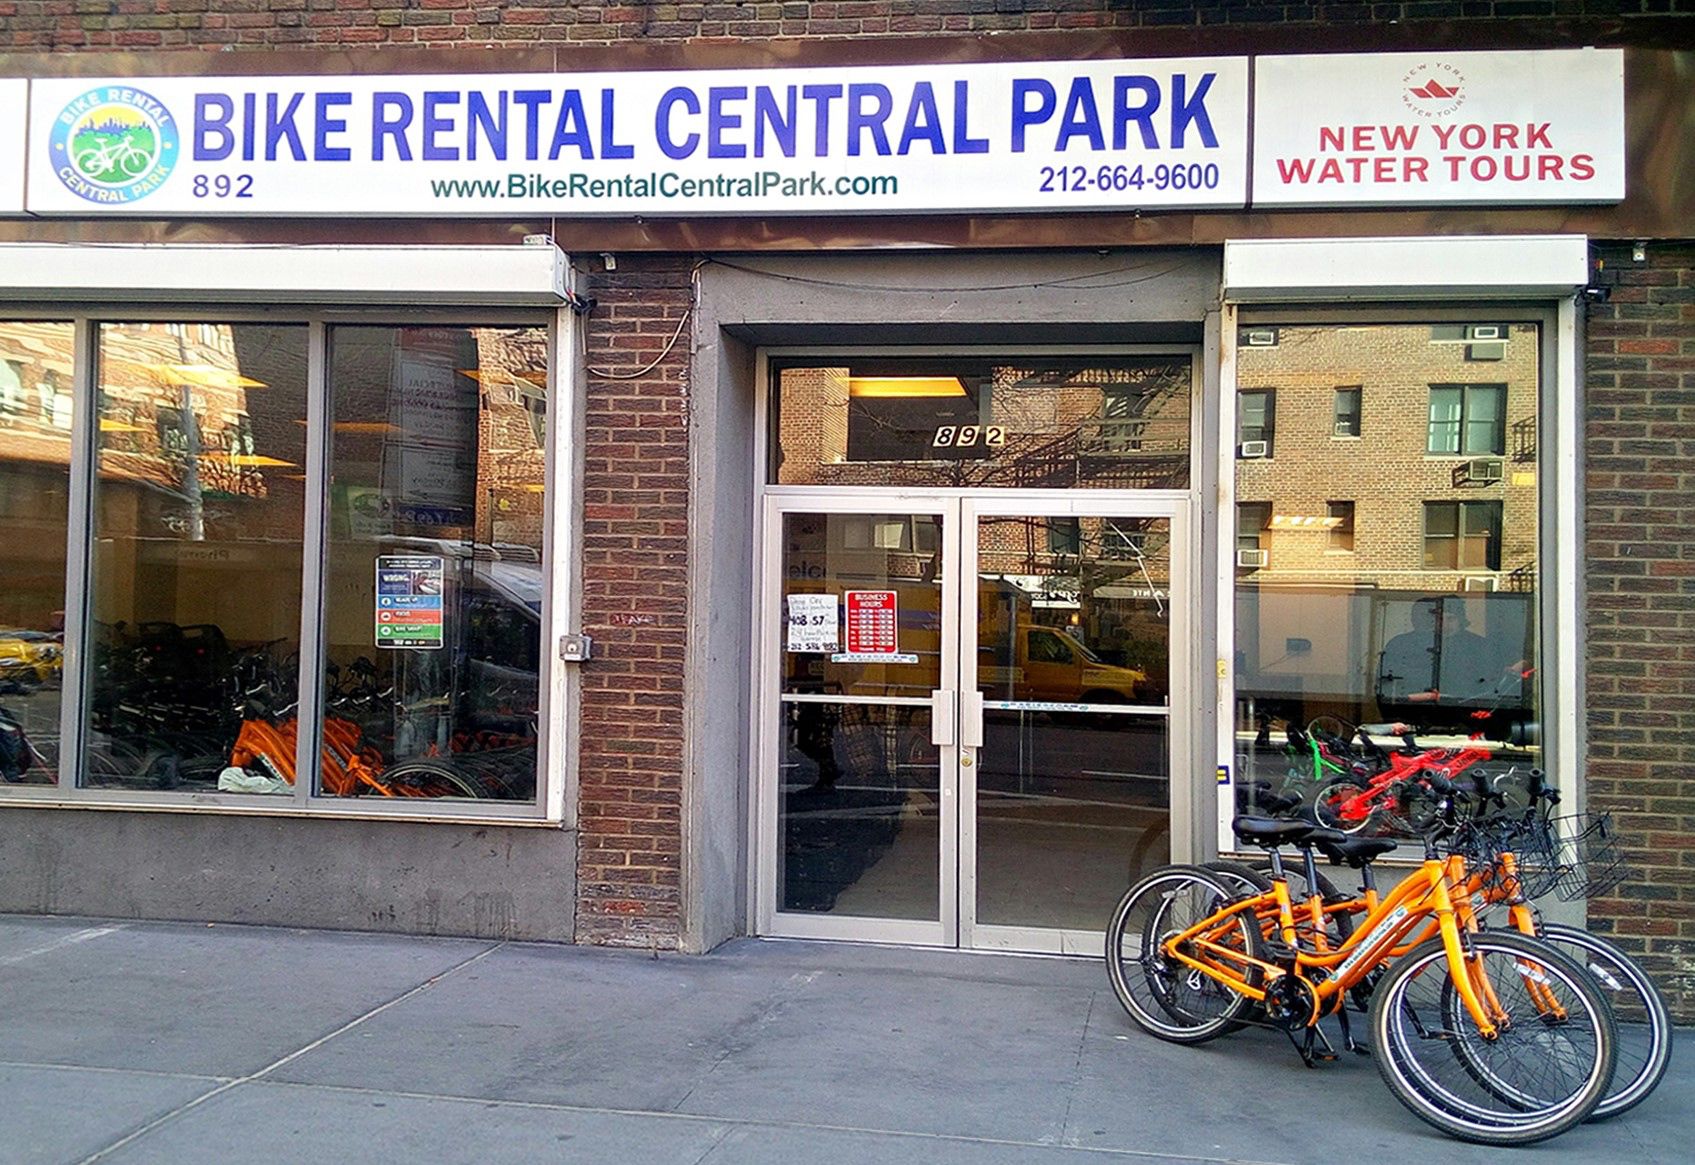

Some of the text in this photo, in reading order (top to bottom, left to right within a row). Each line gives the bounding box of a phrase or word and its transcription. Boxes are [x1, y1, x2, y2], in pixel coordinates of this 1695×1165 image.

[1402, 61, 1466, 83] NEW YORK
[59, 88, 171, 128] BIKE RENTAL
[192, 72, 1220, 161] BIKE RENTAL CENTRAL PARK
[1319, 122, 1553, 152] NEW YORK
[58, 164, 170, 202] CENTRAL PARK
[1039, 163, 1219, 192] 212-664-9600
[1276, 153, 1596, 184] WATER TOURS
[192, 174, 254, 198] 892
[431, 171, 898, 198] www.BikeRentalCentralPark.com
[936, 427, 1003, 445] 892
[855, 593, 888, 601] BUSINESS
